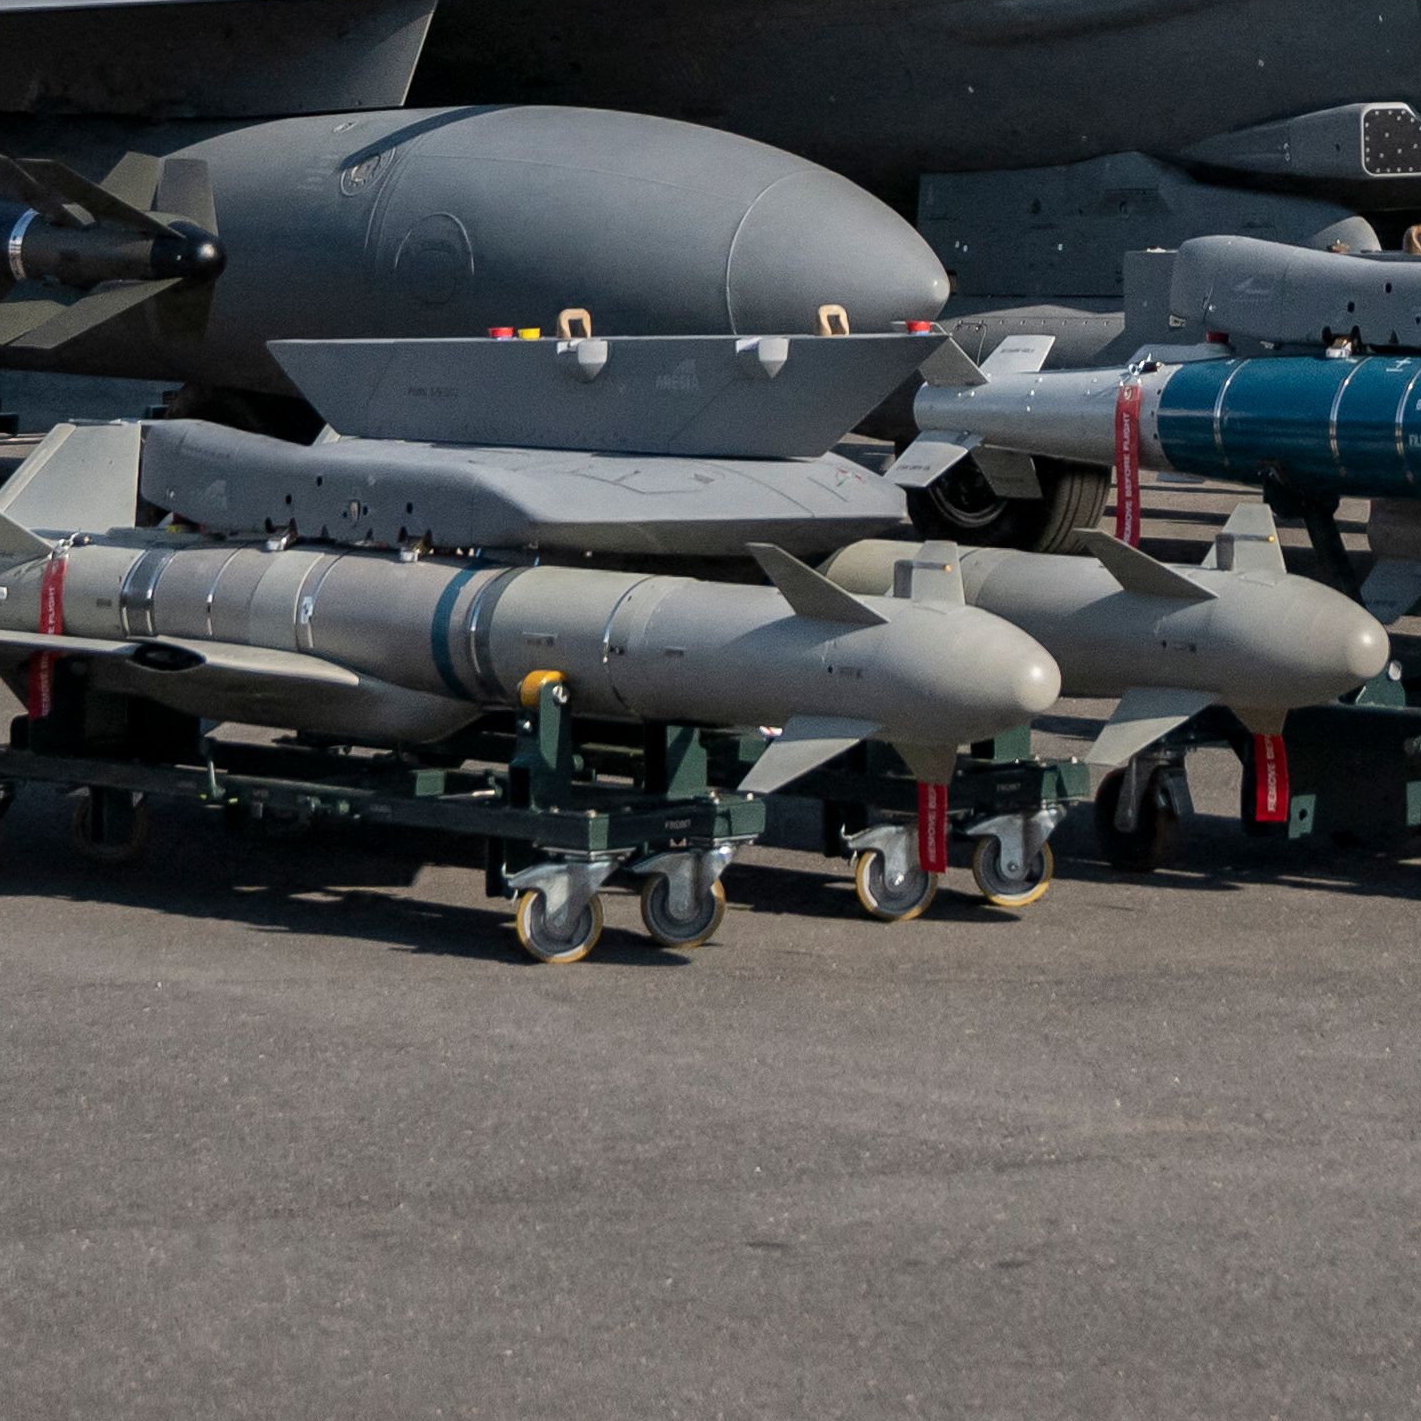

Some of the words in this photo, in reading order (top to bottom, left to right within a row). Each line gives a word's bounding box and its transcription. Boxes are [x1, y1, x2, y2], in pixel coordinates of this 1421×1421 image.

[1122, 412, 1131, 451] FLIGHT
[1123, 454, 1133, 497] BEFORE
[47, 585, 56, 625] FLIGHT
[1266, 761, 1277, 812] REMOVE
[927, 811, 937, 863] REMOVE
